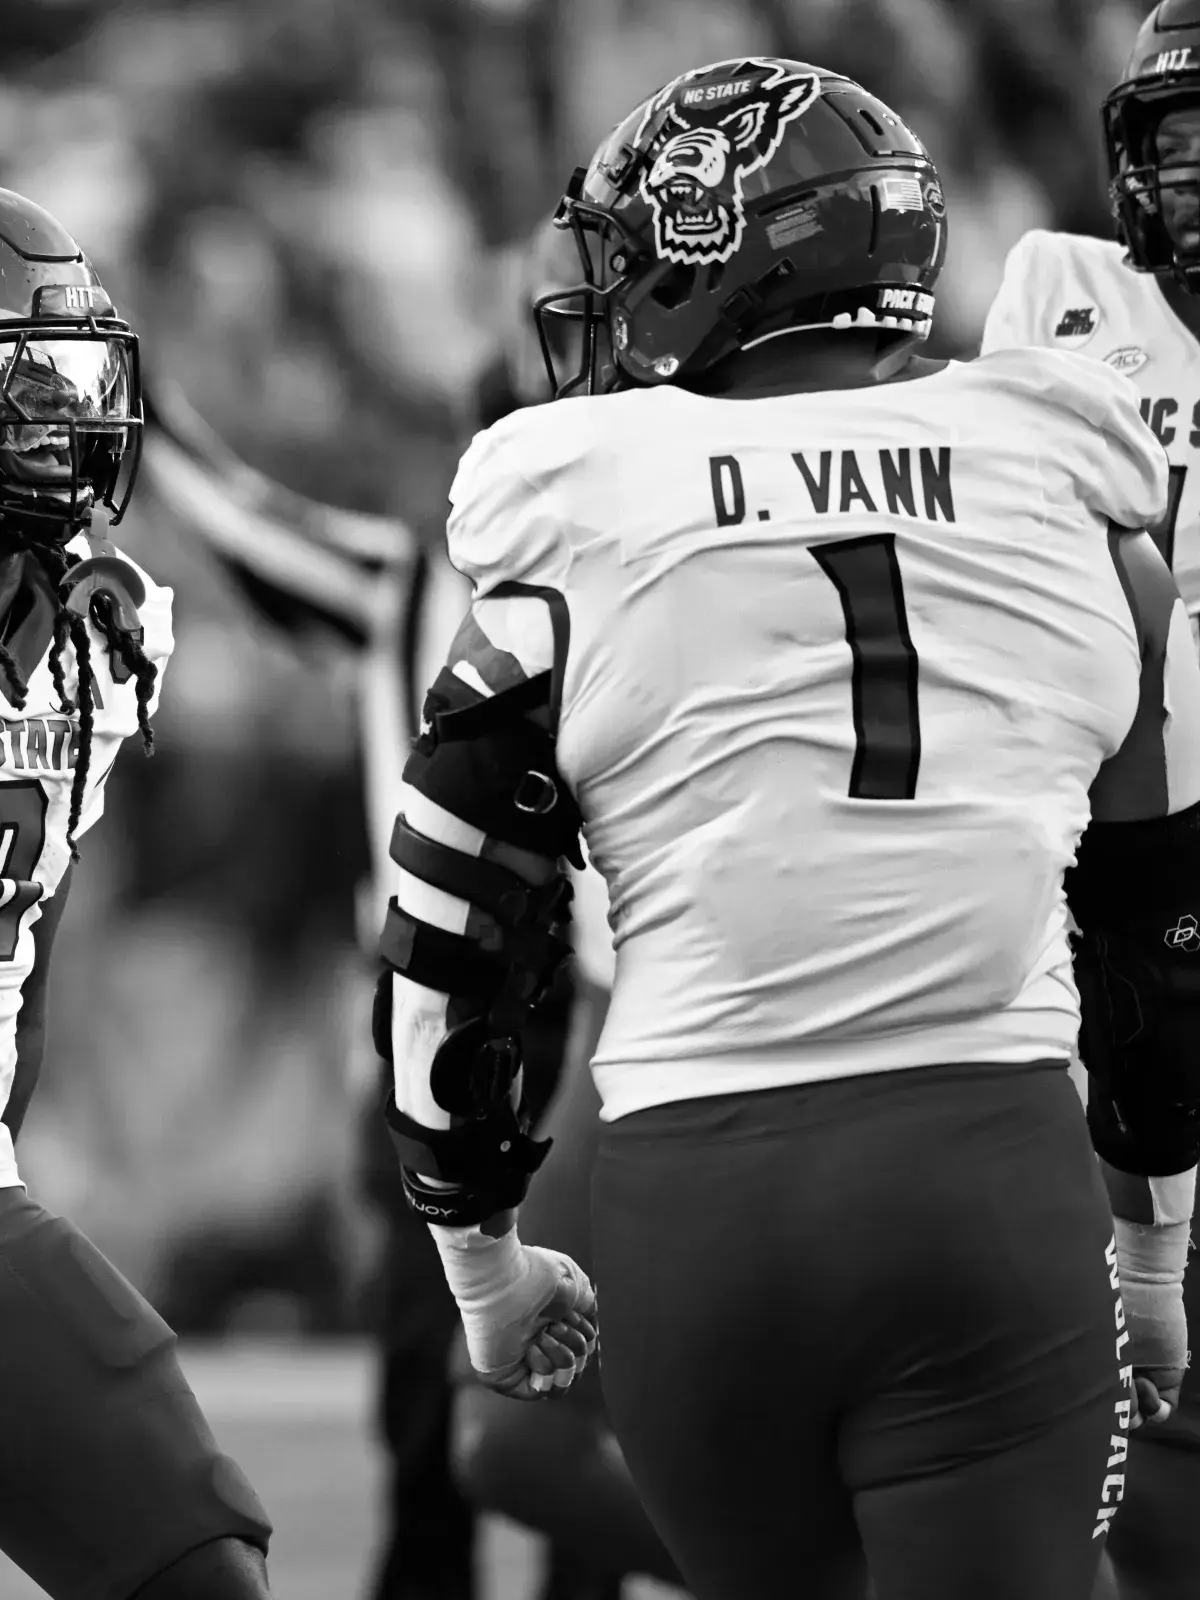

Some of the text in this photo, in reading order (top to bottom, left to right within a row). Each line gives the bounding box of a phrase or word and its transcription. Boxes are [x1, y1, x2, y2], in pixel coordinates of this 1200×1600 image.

[684, 79, 752, 104] NC STATE
[65, 286, 94, 308] HTT
[881, 288, 917, 310] PACK
[709, 446, 956, 528] D. VANN
[806, 532, 922, 800] 1
[1091, 1232, 1134, 1540] WOLFPACK
